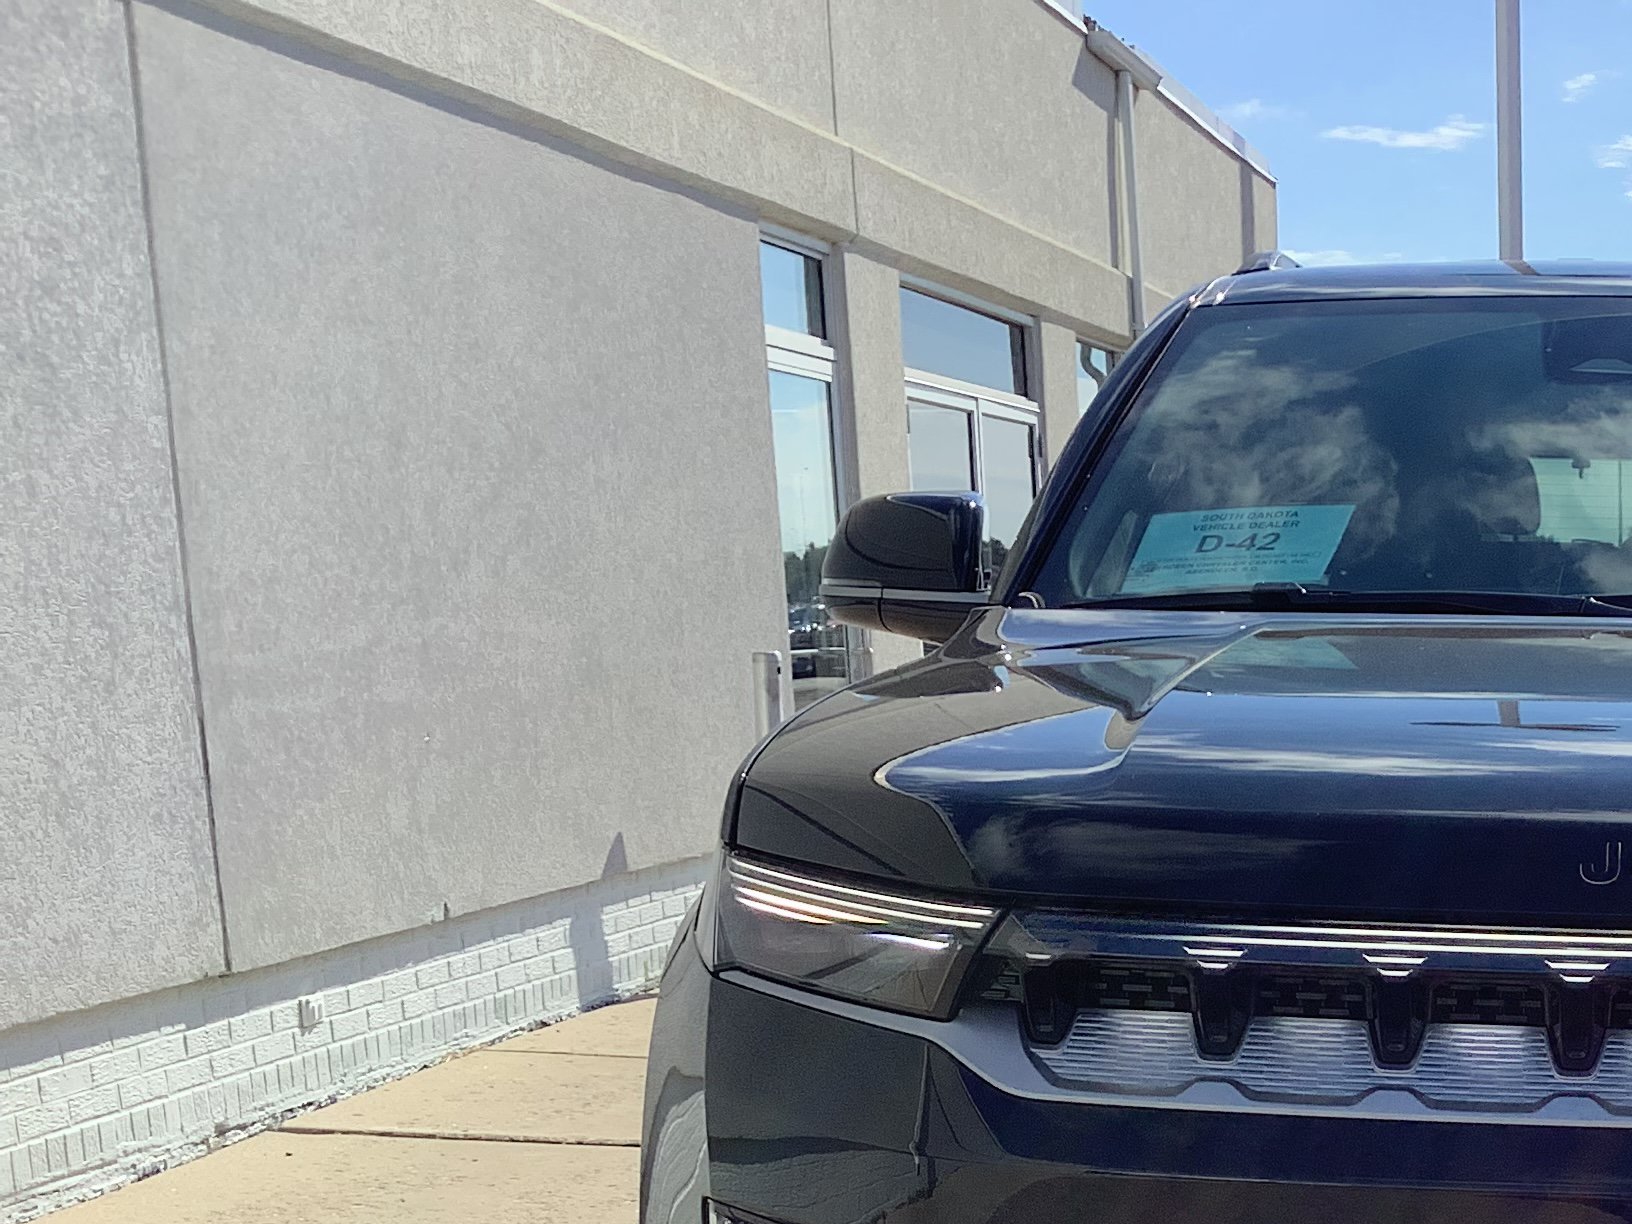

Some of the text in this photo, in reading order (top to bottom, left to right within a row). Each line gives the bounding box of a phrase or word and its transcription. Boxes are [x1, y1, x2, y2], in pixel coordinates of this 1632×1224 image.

[1201, 510, 1299, 523] SOUTH DAKOTA
[1193, 520, 1300, 532] VEHICLE DEALER
[1194, 532, 1281, 553] D-42
